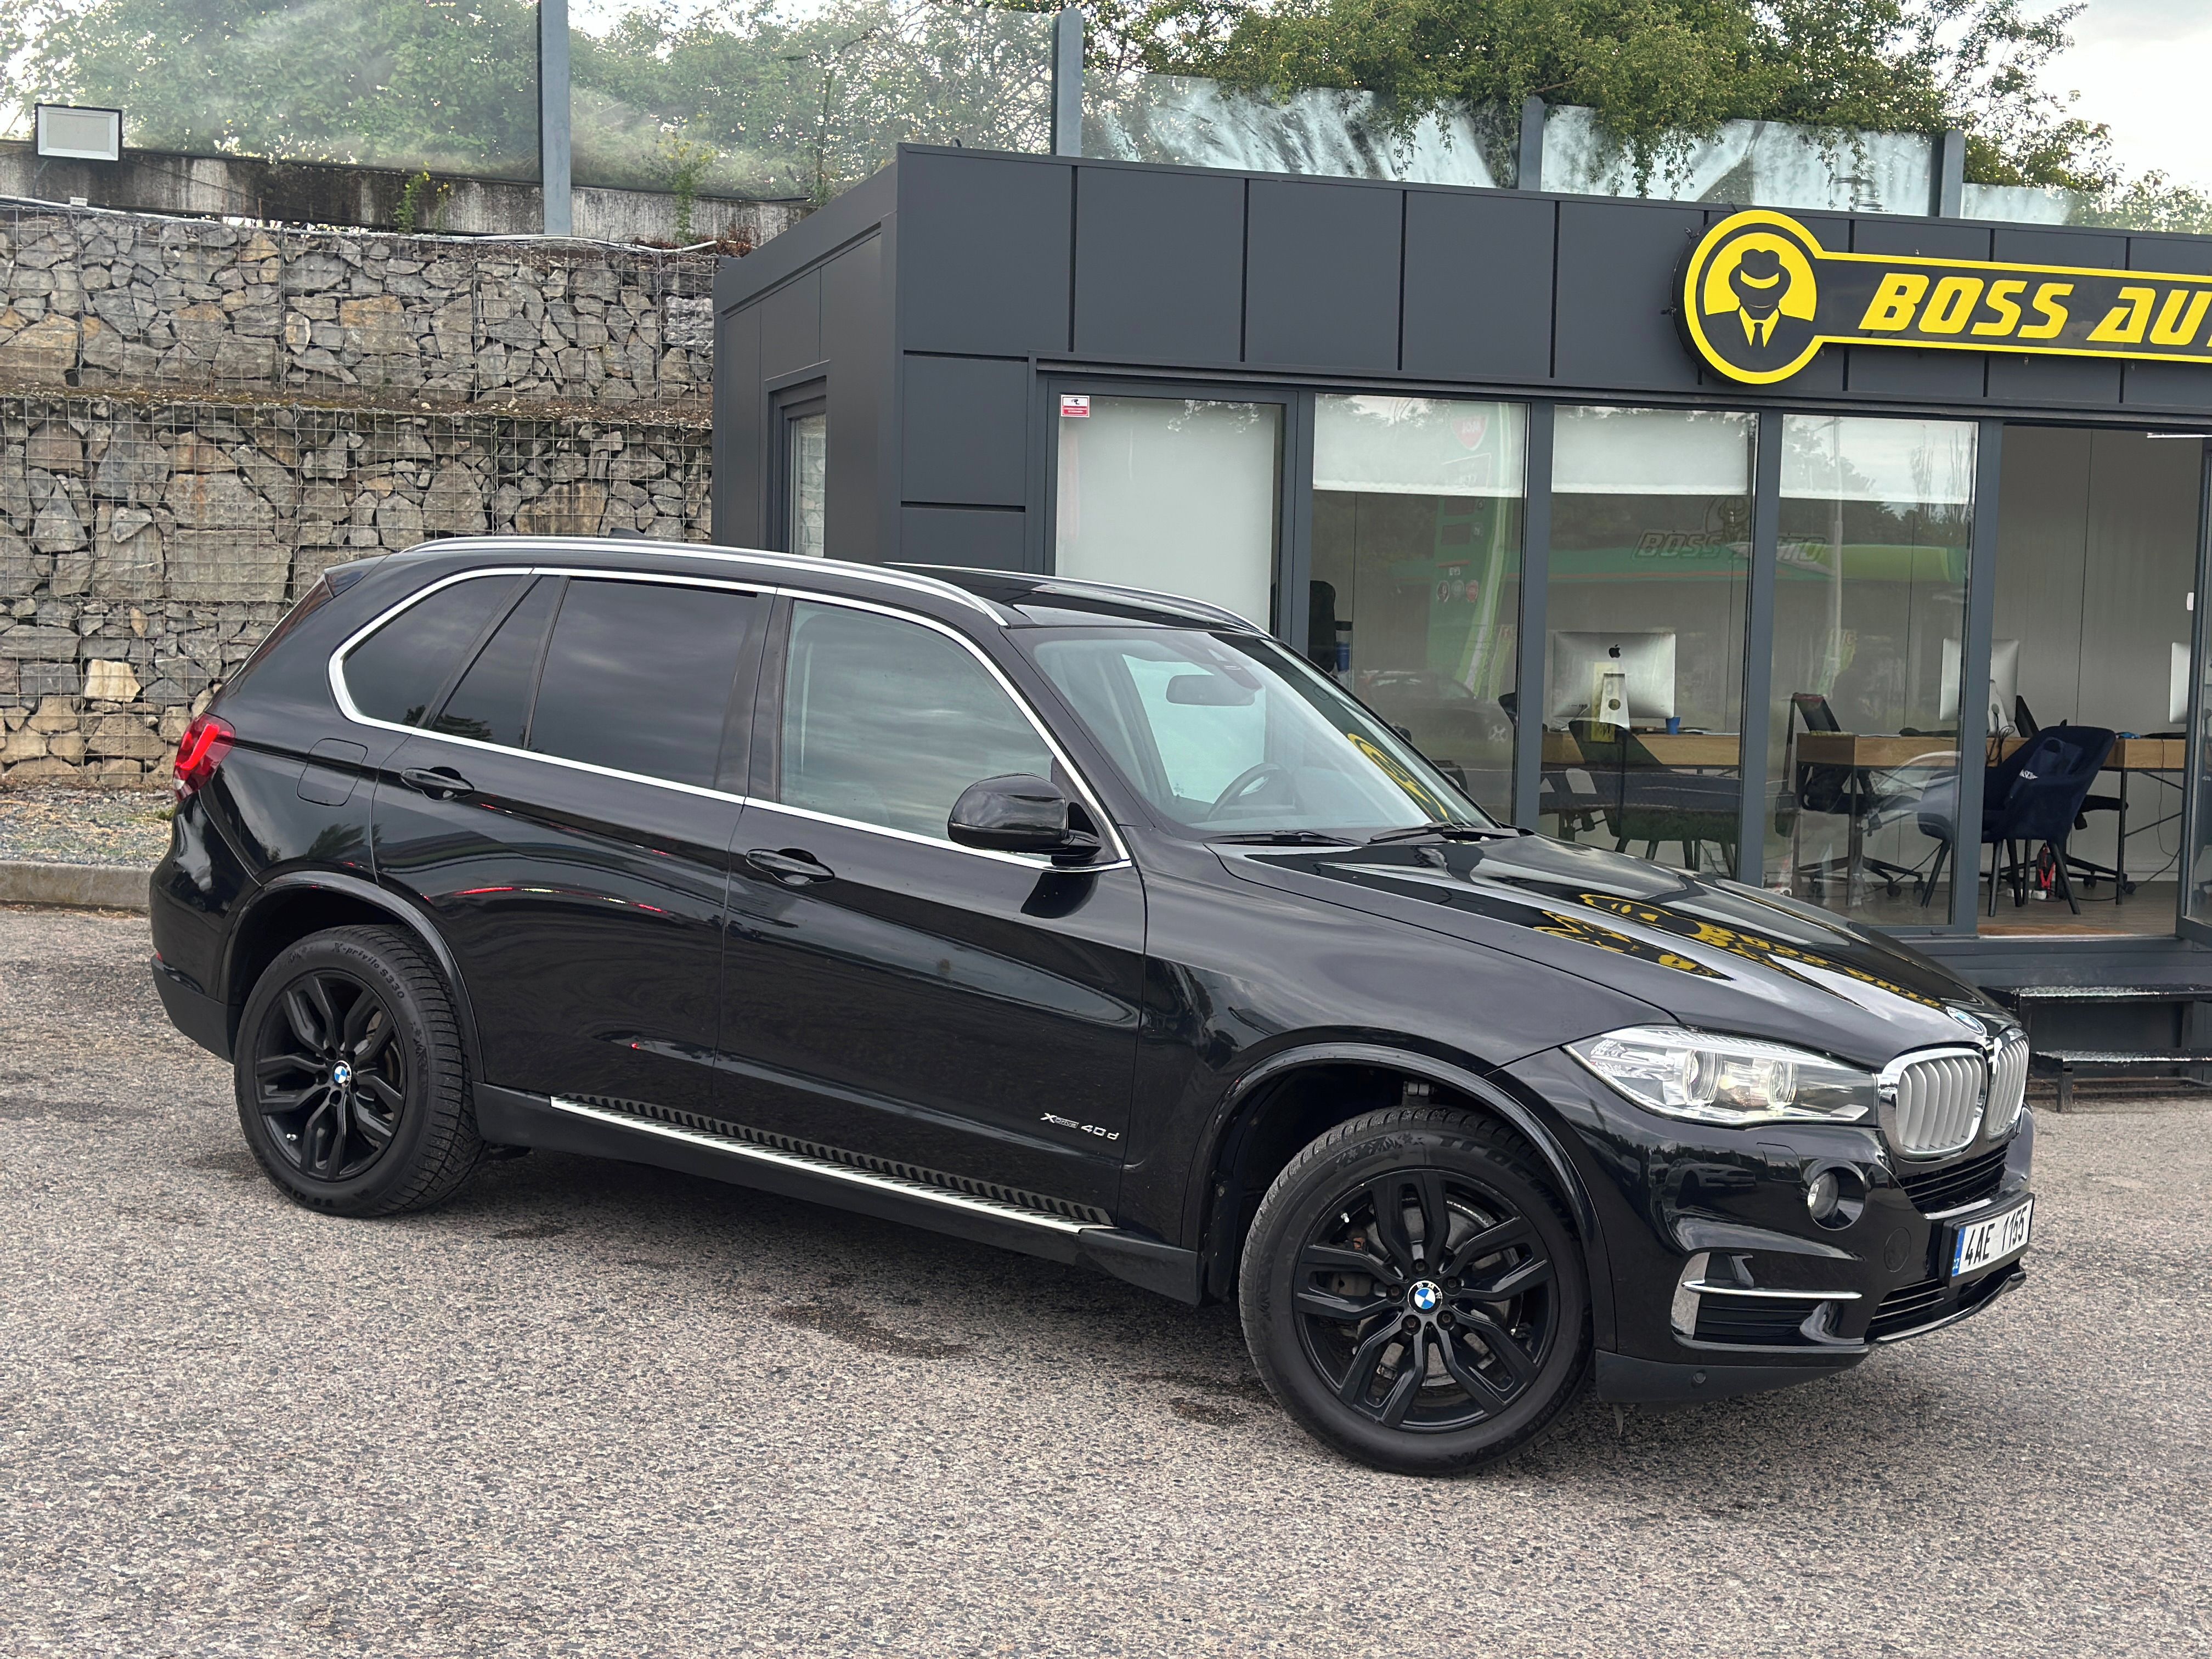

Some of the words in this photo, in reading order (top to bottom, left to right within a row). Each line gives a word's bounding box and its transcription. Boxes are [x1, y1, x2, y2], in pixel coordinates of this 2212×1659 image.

[1858, 273, 2074, 338] BOSS
[2086, 286, 2212, 347] AU
[1634, 532, 1724, 560] BOSS
[1965, 1223, 1995, 1266] 4AE
[2001, 1205, 2028, 1252] 1155
